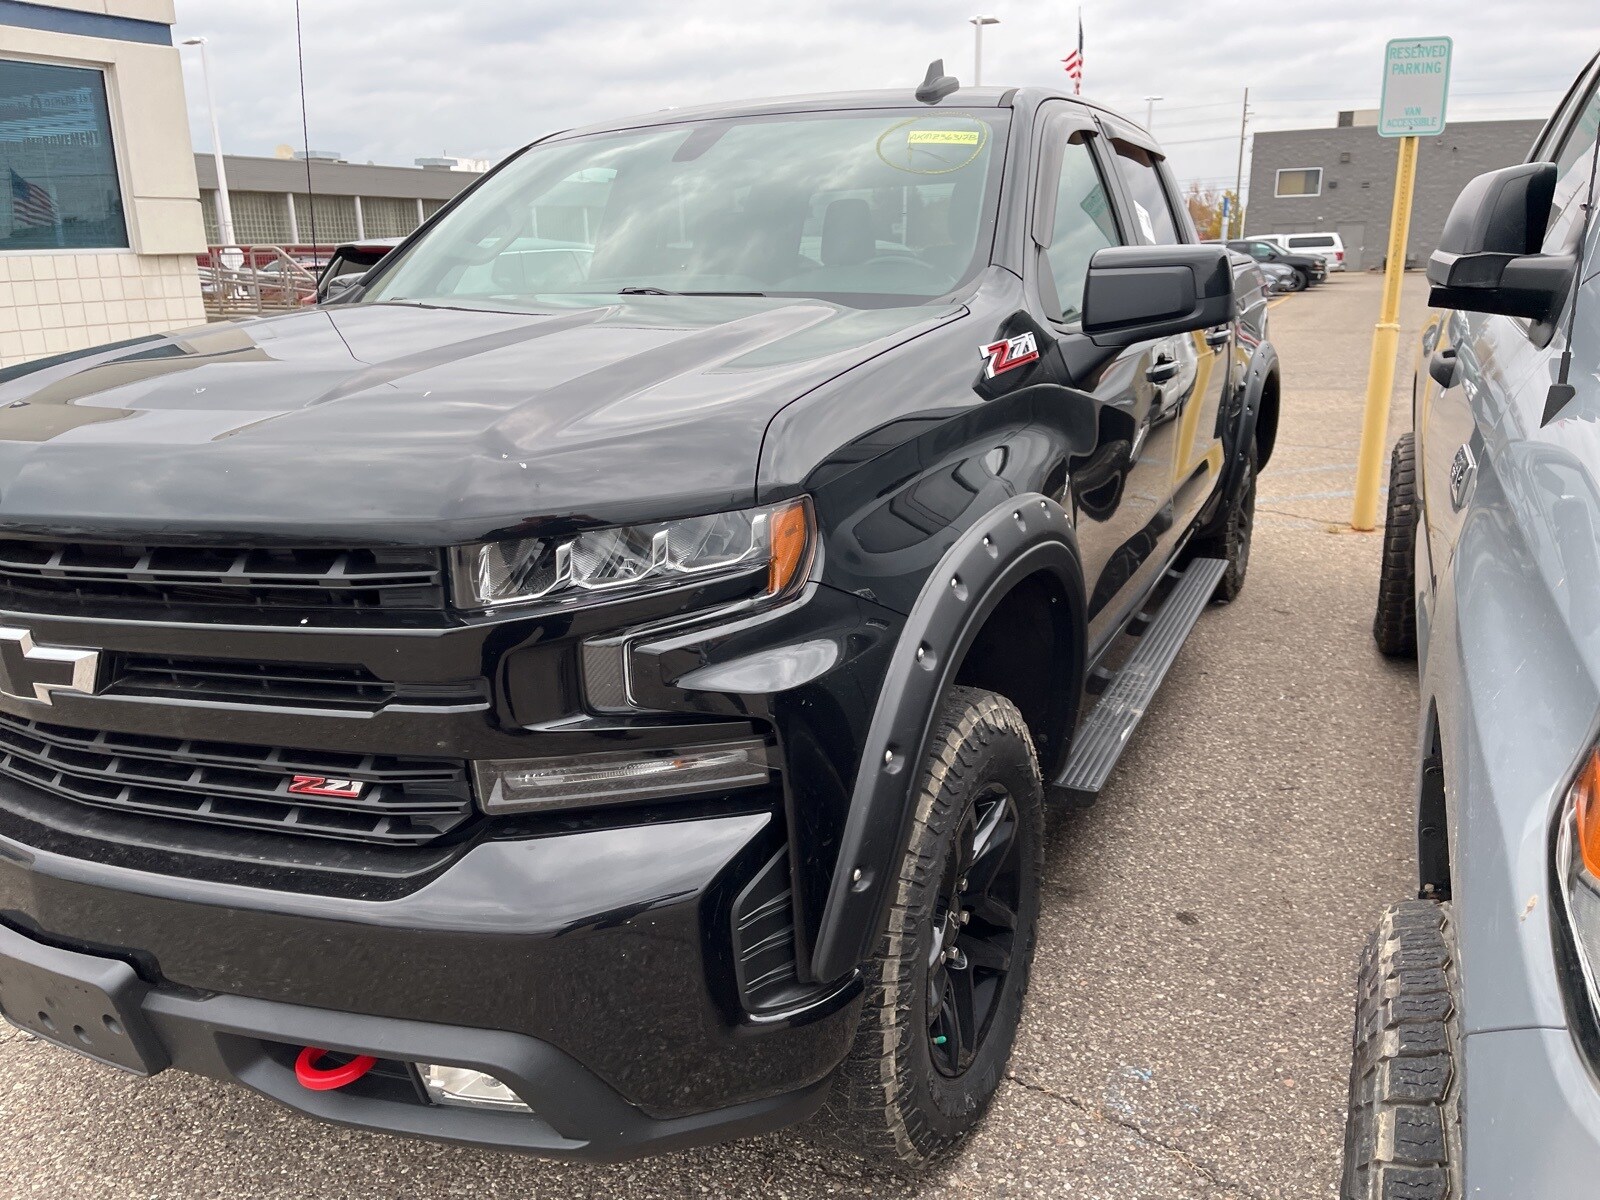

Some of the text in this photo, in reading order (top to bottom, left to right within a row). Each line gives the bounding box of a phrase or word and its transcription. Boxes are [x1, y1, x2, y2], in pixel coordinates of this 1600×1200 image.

[1389, 45, 1447, 59] RESERVED
[1392, 62, 1442, 74] PARKING
[1404, 106, 1421, 116] VAN
[1387, 117, 1437, 127] ACCESSIBLE
[978, 331, 1039, 379] Z71
[288, 775, 363, 798] Z71
